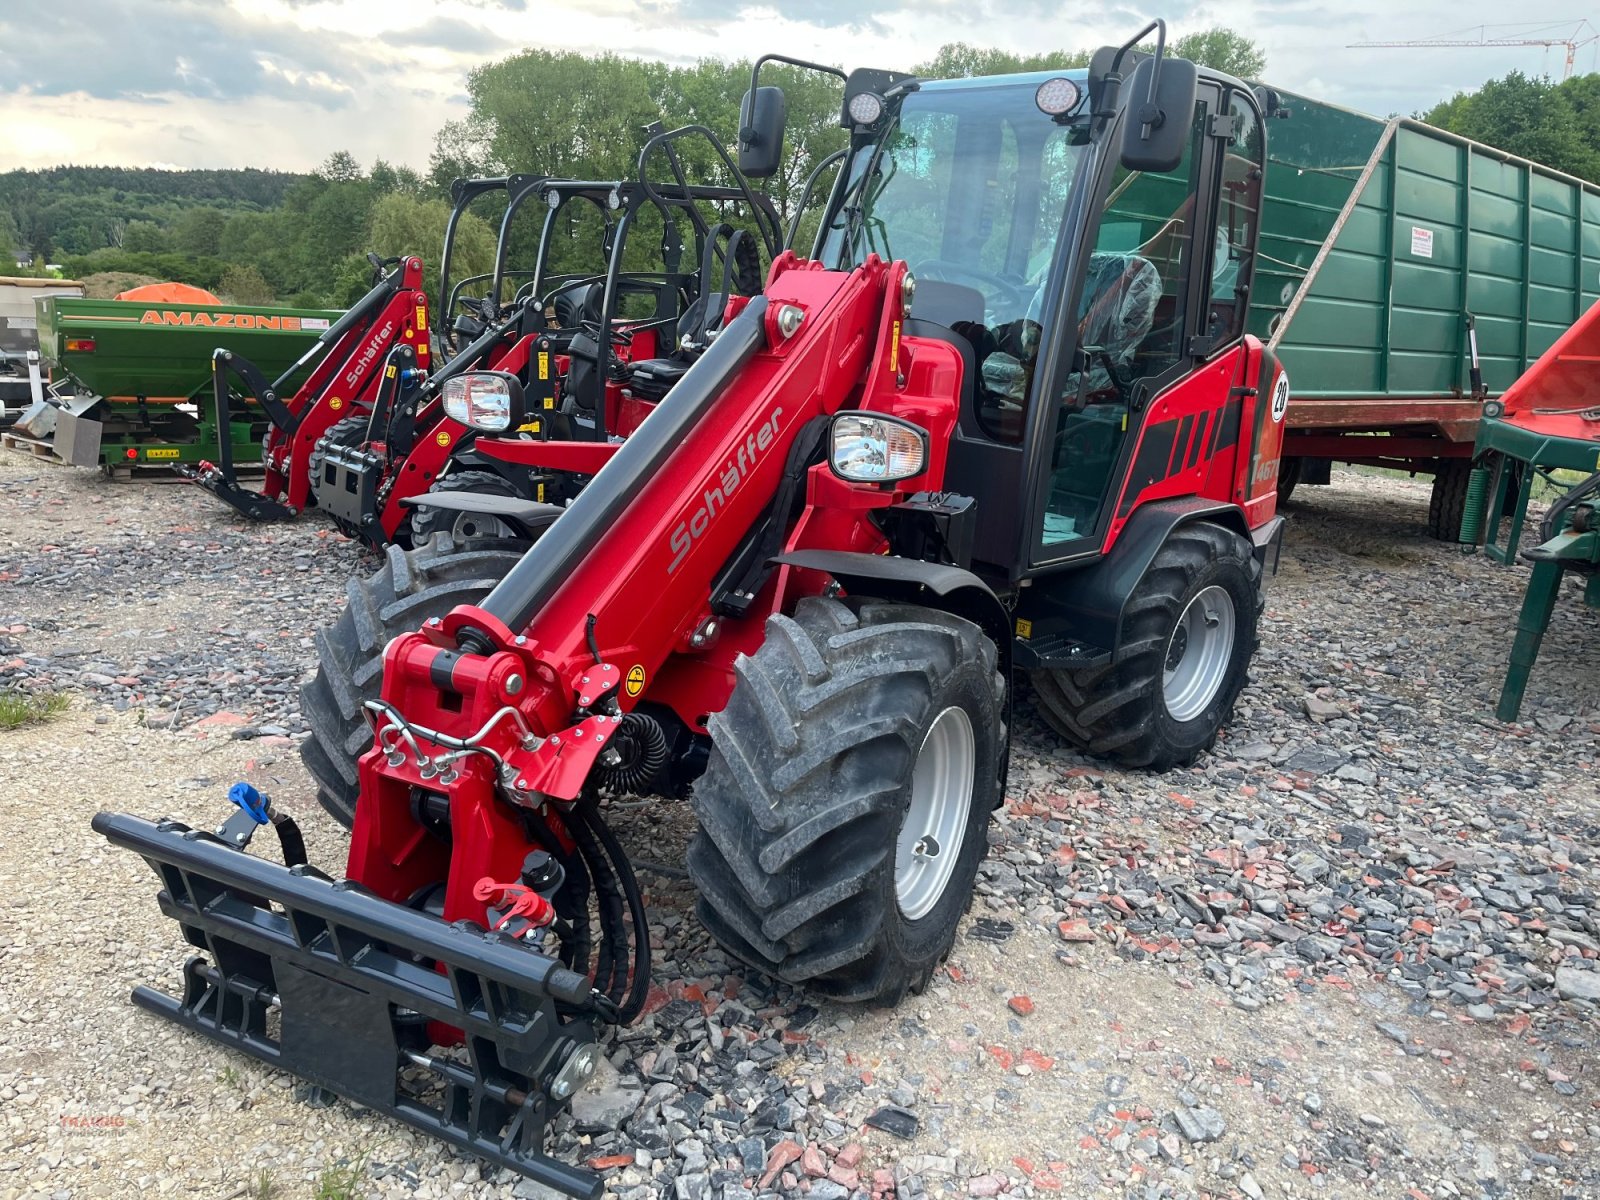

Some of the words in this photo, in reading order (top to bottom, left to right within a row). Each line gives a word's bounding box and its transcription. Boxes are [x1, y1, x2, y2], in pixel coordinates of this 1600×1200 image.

[140, 310, 301, 331] AMAZONE
[346, 320, 393, 390] Schäffer
[1274, 381, 1287, 412] 20
[667, 407, 783, 575] Schäffer
